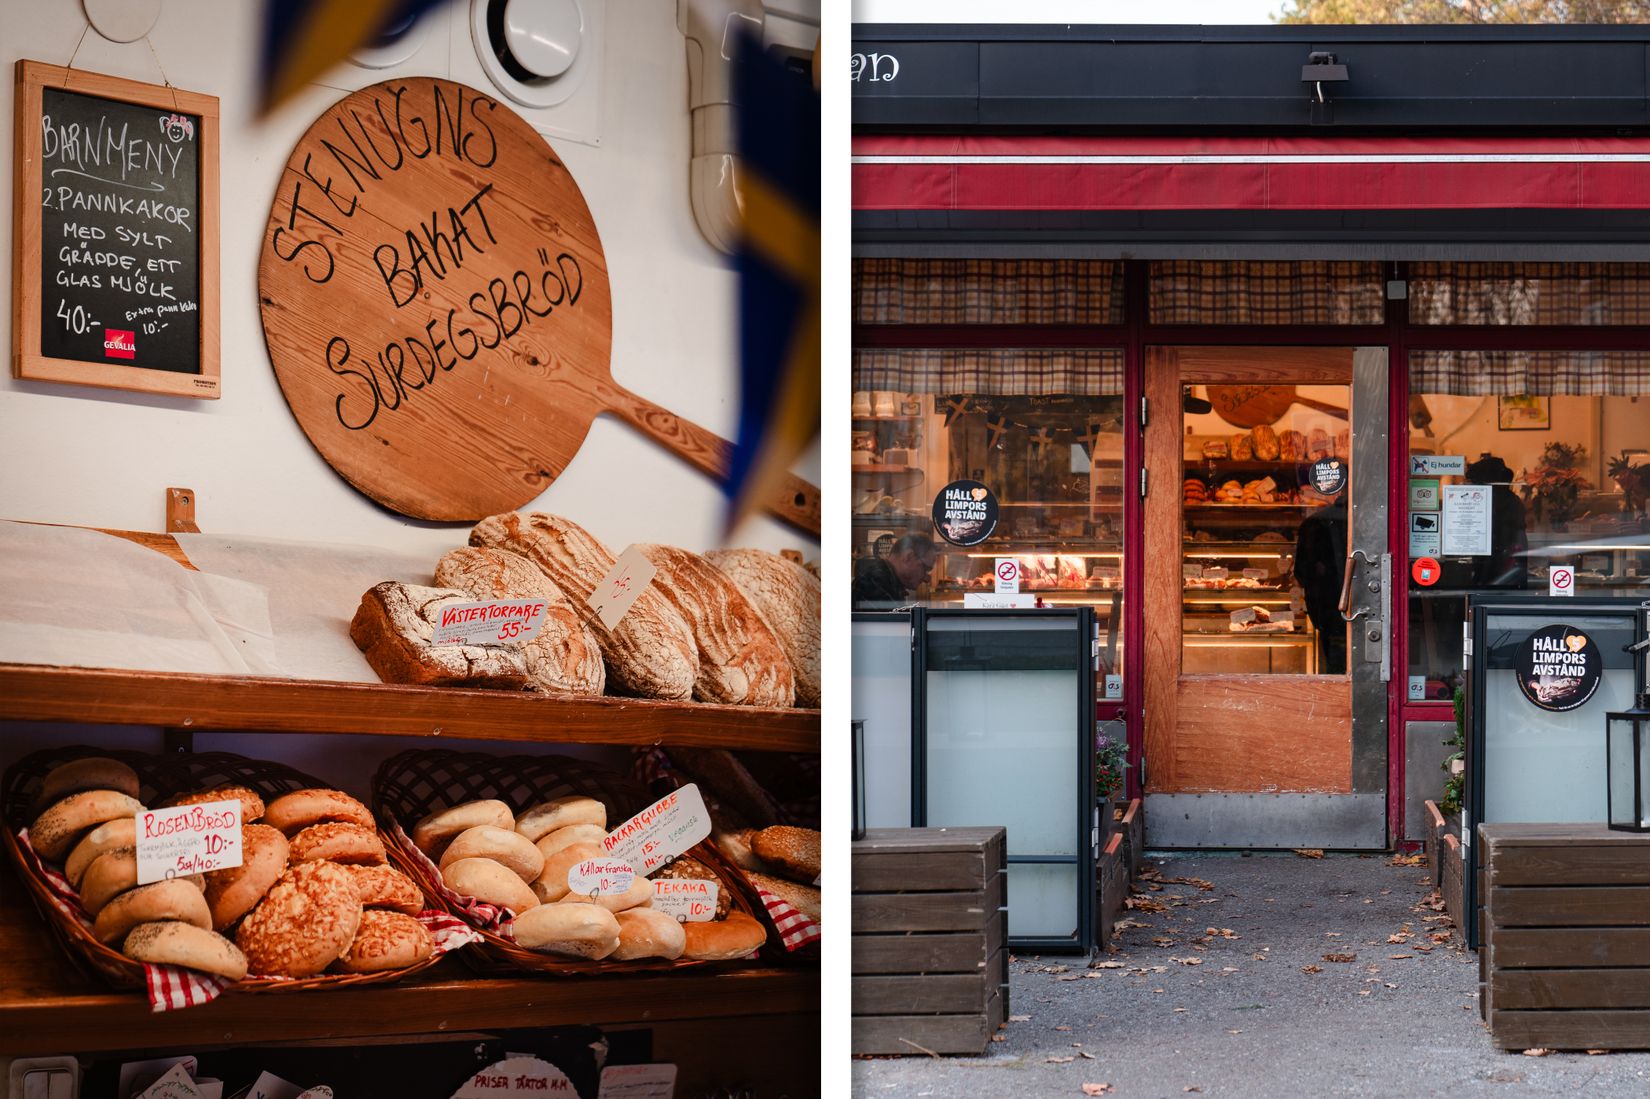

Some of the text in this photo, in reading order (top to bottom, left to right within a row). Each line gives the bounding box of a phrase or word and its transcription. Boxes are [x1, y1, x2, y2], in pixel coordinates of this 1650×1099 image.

[272, 84, 498, 284] STENUGNS
[63, 222, 172, 249] MED SYLT
[372, 183, 498, 309] BAKAT
[147, 258, 182, 273] ETT
[56, 270, 177, 300] GLAS MJÖLK
[56, 298, 102, 335] 40:-
[142, 320, 169, 335] 10:-
[103, 341, 136, 352] GEVALIA
[325, 248, 583, 431] SURDEGSBRÖD
[1315, 463, 1331, 471] HÅLL
[1430, 461, 1438, 469] Ej
[945, 488, 972, 501] HÅLL
[945, 501, 987, 511] LIMPORS
[944, 509, 987, 520] AVSTÅND
[441, 603, 545, 629] VÄSTERTORPARE
[497, 621, 532, 641] 55:-
[1533, 636, 1567, 652] HÅLL
[1532, 651, 1587, 665] LIMPORS
[1532, 663, 1587, 677] AVSTÅND
[603, 793, 678, 852] RACKARGUBBE
[204, 834, 235, 855] 10:-
[641, 840, 661, 857] 15:-
[600, 878, 617, 891] 10:-
[655, 881, 708, 895] TEKAKA
[689, 902, 711, 916] 10:-
[473, 1074, 509, 1089] PRISER
